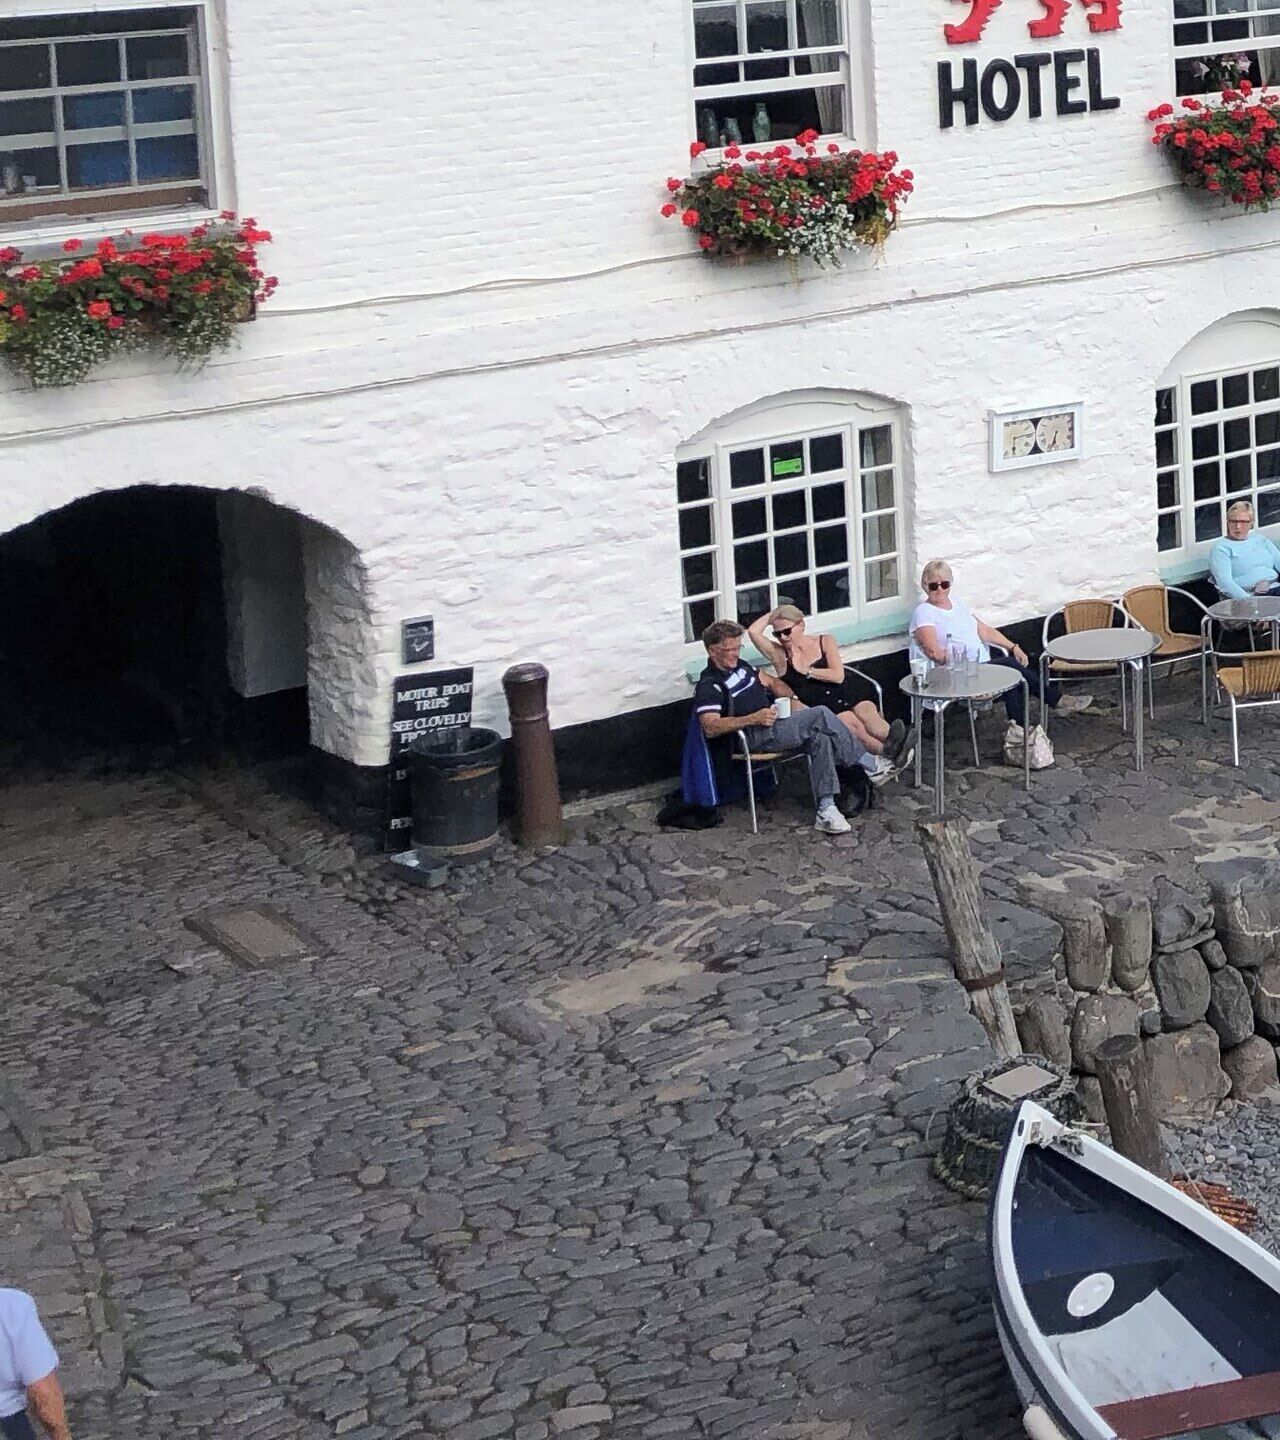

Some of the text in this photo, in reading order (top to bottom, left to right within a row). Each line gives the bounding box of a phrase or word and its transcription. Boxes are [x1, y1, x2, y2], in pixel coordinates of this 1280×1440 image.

[937, 47, 1121, 129] HOTEL
[397, 682, 472, 703] MOTOR BOAT
[415, 696, 450, 712] TRIPS
[392, 720, 414, 732] SEE
[414, 712, 471, 730] CLOVELLY
